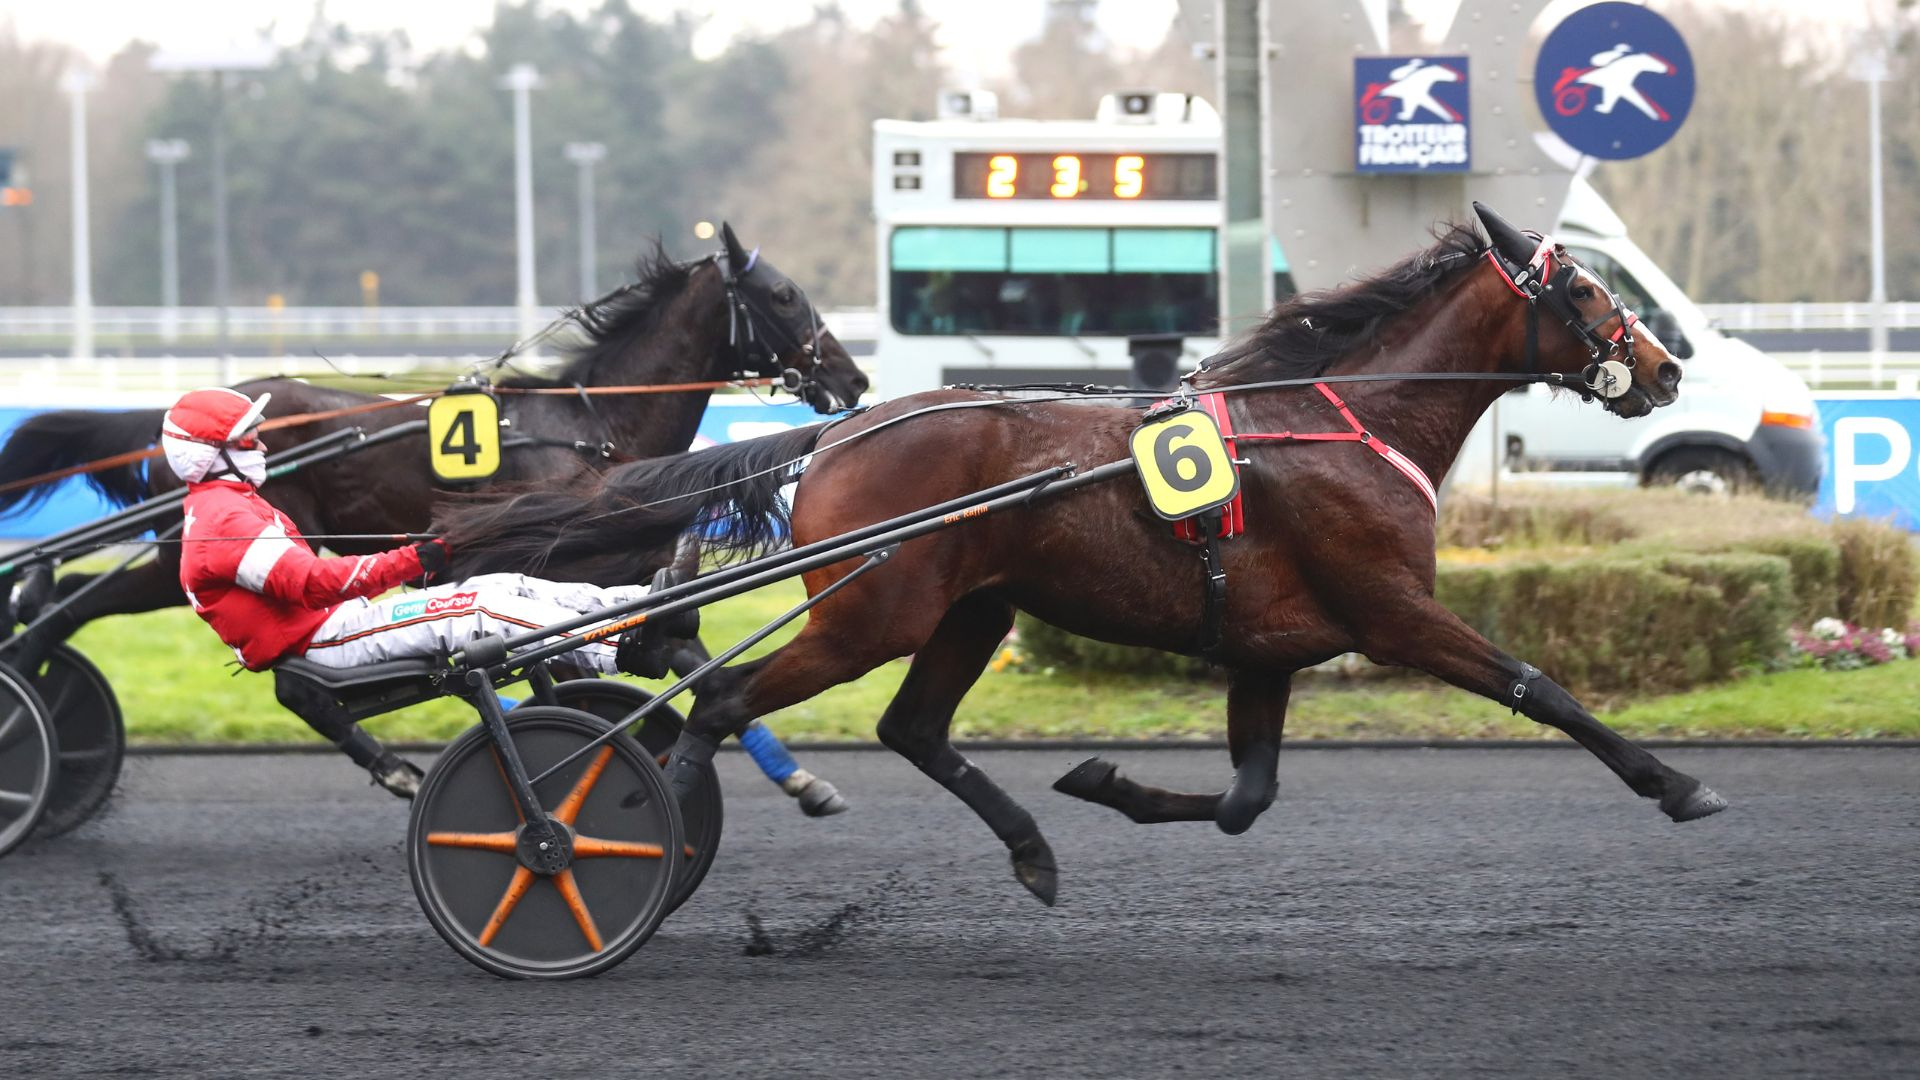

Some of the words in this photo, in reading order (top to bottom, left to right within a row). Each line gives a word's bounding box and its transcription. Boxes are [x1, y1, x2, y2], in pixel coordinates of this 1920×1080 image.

[1360, 124, 1467, 144] TROTTEUR
[987, 155, 1018, 198] 2
[1051, 155, 1081, 198] 3
[1114, 155, 1145, 198] 5
[440, 411, 482, 465] 4
[1153, 424, 1212, 492] 6
[1834, 416, 1920, 515] P
[427, 595, 474, 611] Courses
